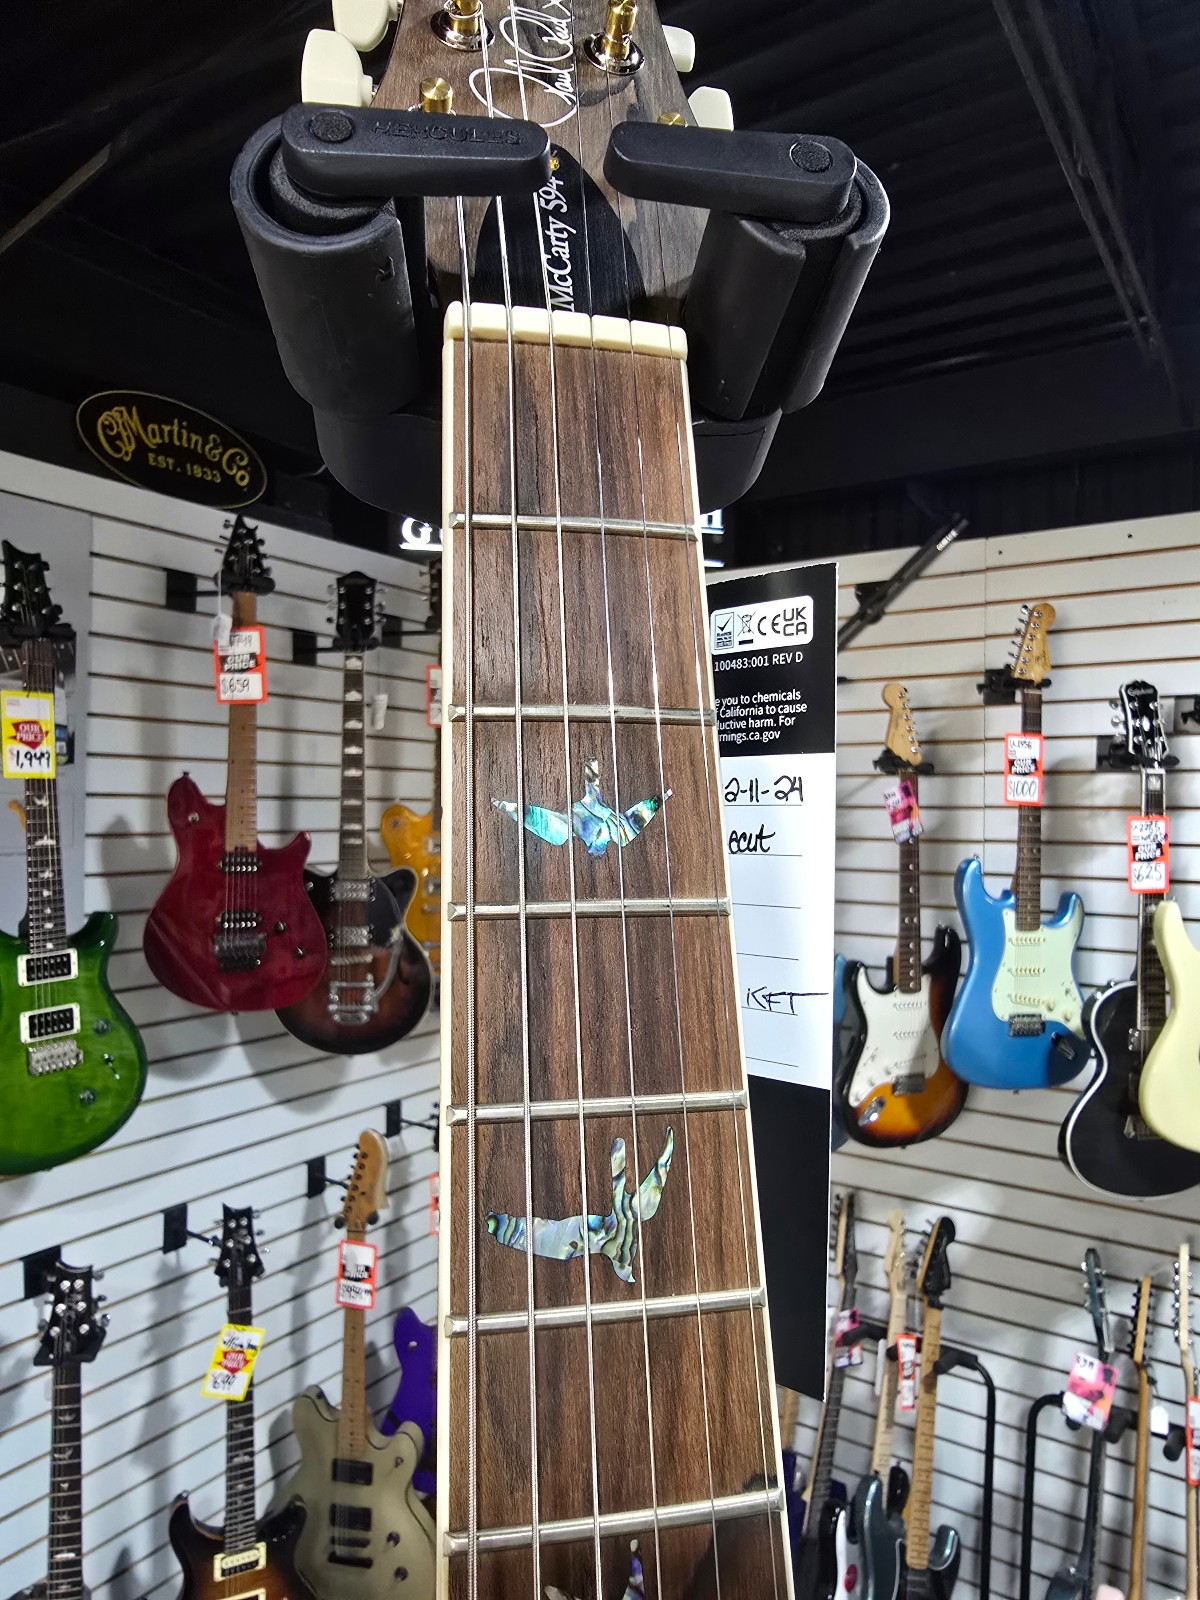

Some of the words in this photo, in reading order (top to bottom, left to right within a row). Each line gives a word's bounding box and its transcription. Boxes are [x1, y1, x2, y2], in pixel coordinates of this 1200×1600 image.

[371, 121, 522, 145] HERCULES
[539, 175, 568, 213] 594
[544, 219, 577, 312] McCarty
[783, 606, 807, 622] UK
[783, 621, 808, 637] CA
[223, 659, 257, 672] PRICE
[772, 652, 793, 666] REV
[795, 651, 804, 663] D
[722, 697, 738, 708] you
[740, 695, 751, 705] to
[752, 688, 801, 704] chemicals
[720, 704, 764, 718] California
[765, 704, 777, 715] to
[778, 702, 808, 714] cause
[18, 722, 41, 732] OUR
[748, 717, 777, 728] harm.
[778, 715, 796, 726] For
[16, 731, 43, 742] PRICE
